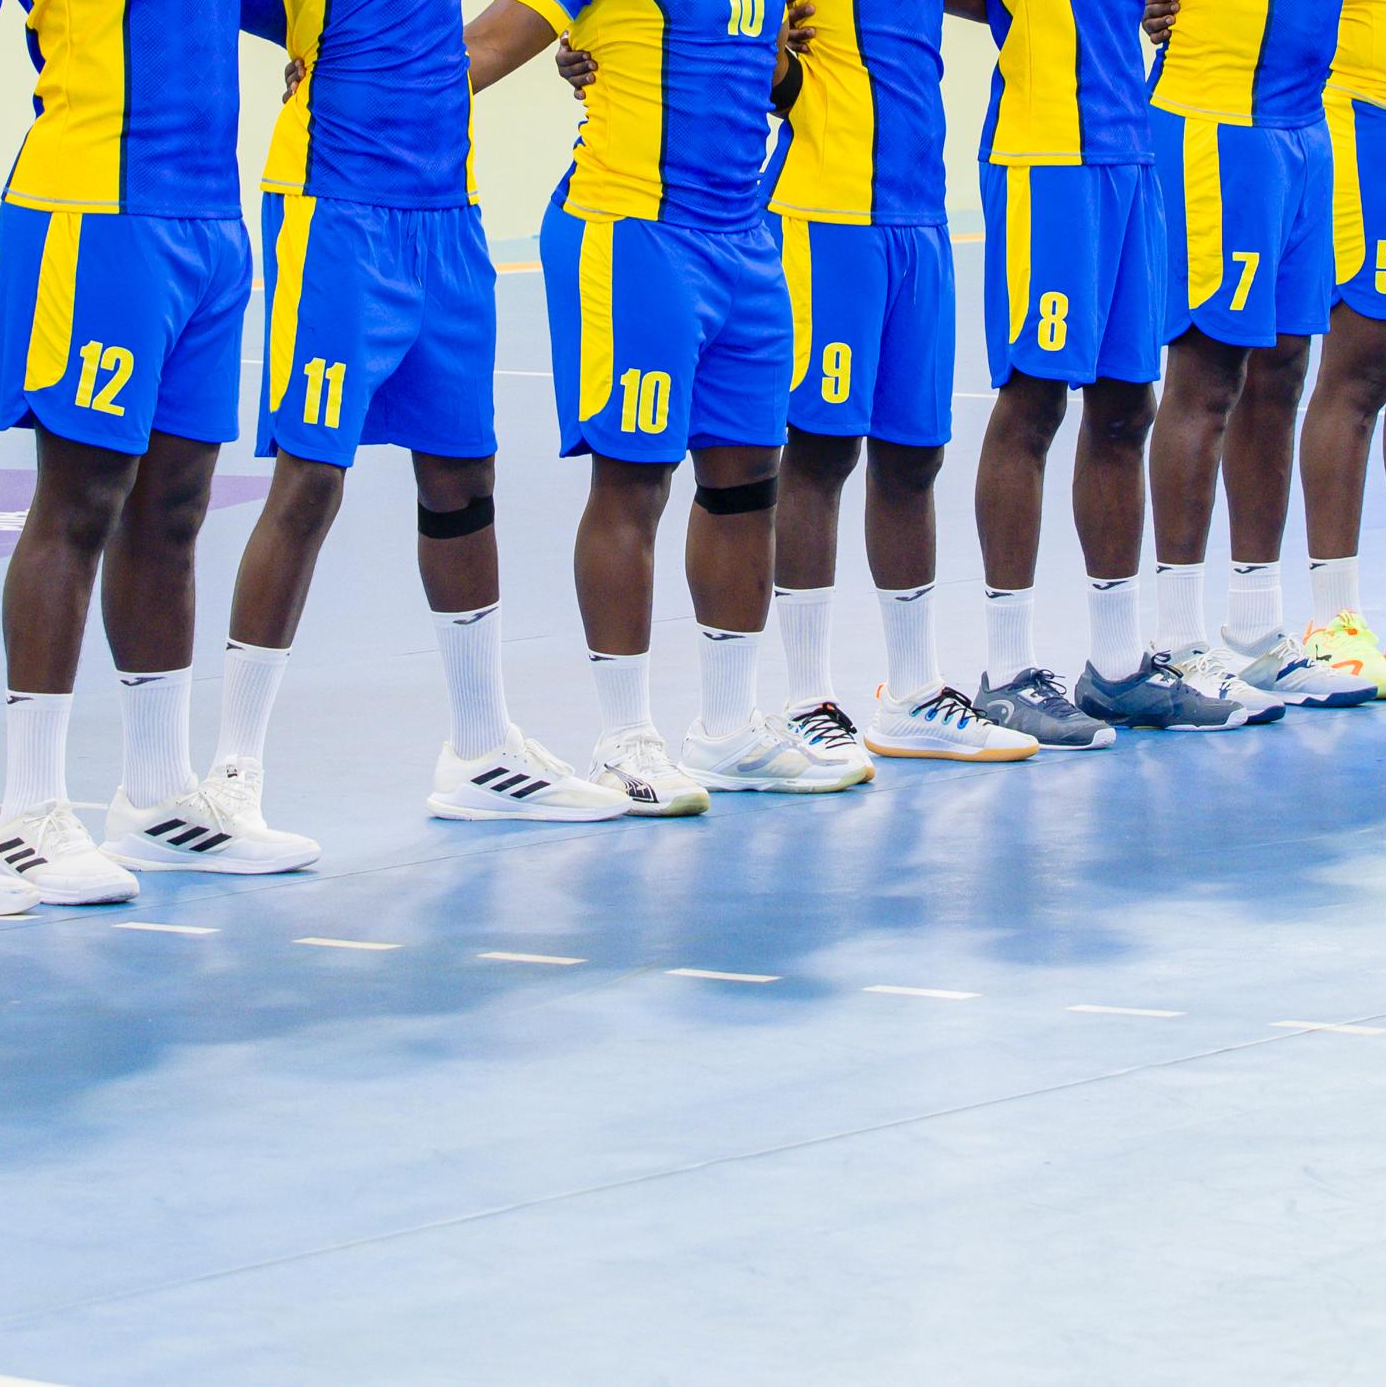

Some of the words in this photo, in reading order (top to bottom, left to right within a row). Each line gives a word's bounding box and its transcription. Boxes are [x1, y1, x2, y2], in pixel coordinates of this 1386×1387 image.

[1229, 251, 1260, 311] 7
[1037, 291, 1069, 352] 8
[75, 340, 134, 417] 12
[303, 357, 347, 429] 11
[620, 368, 672, 434] 10
[821, 342, 852, 404] 9
